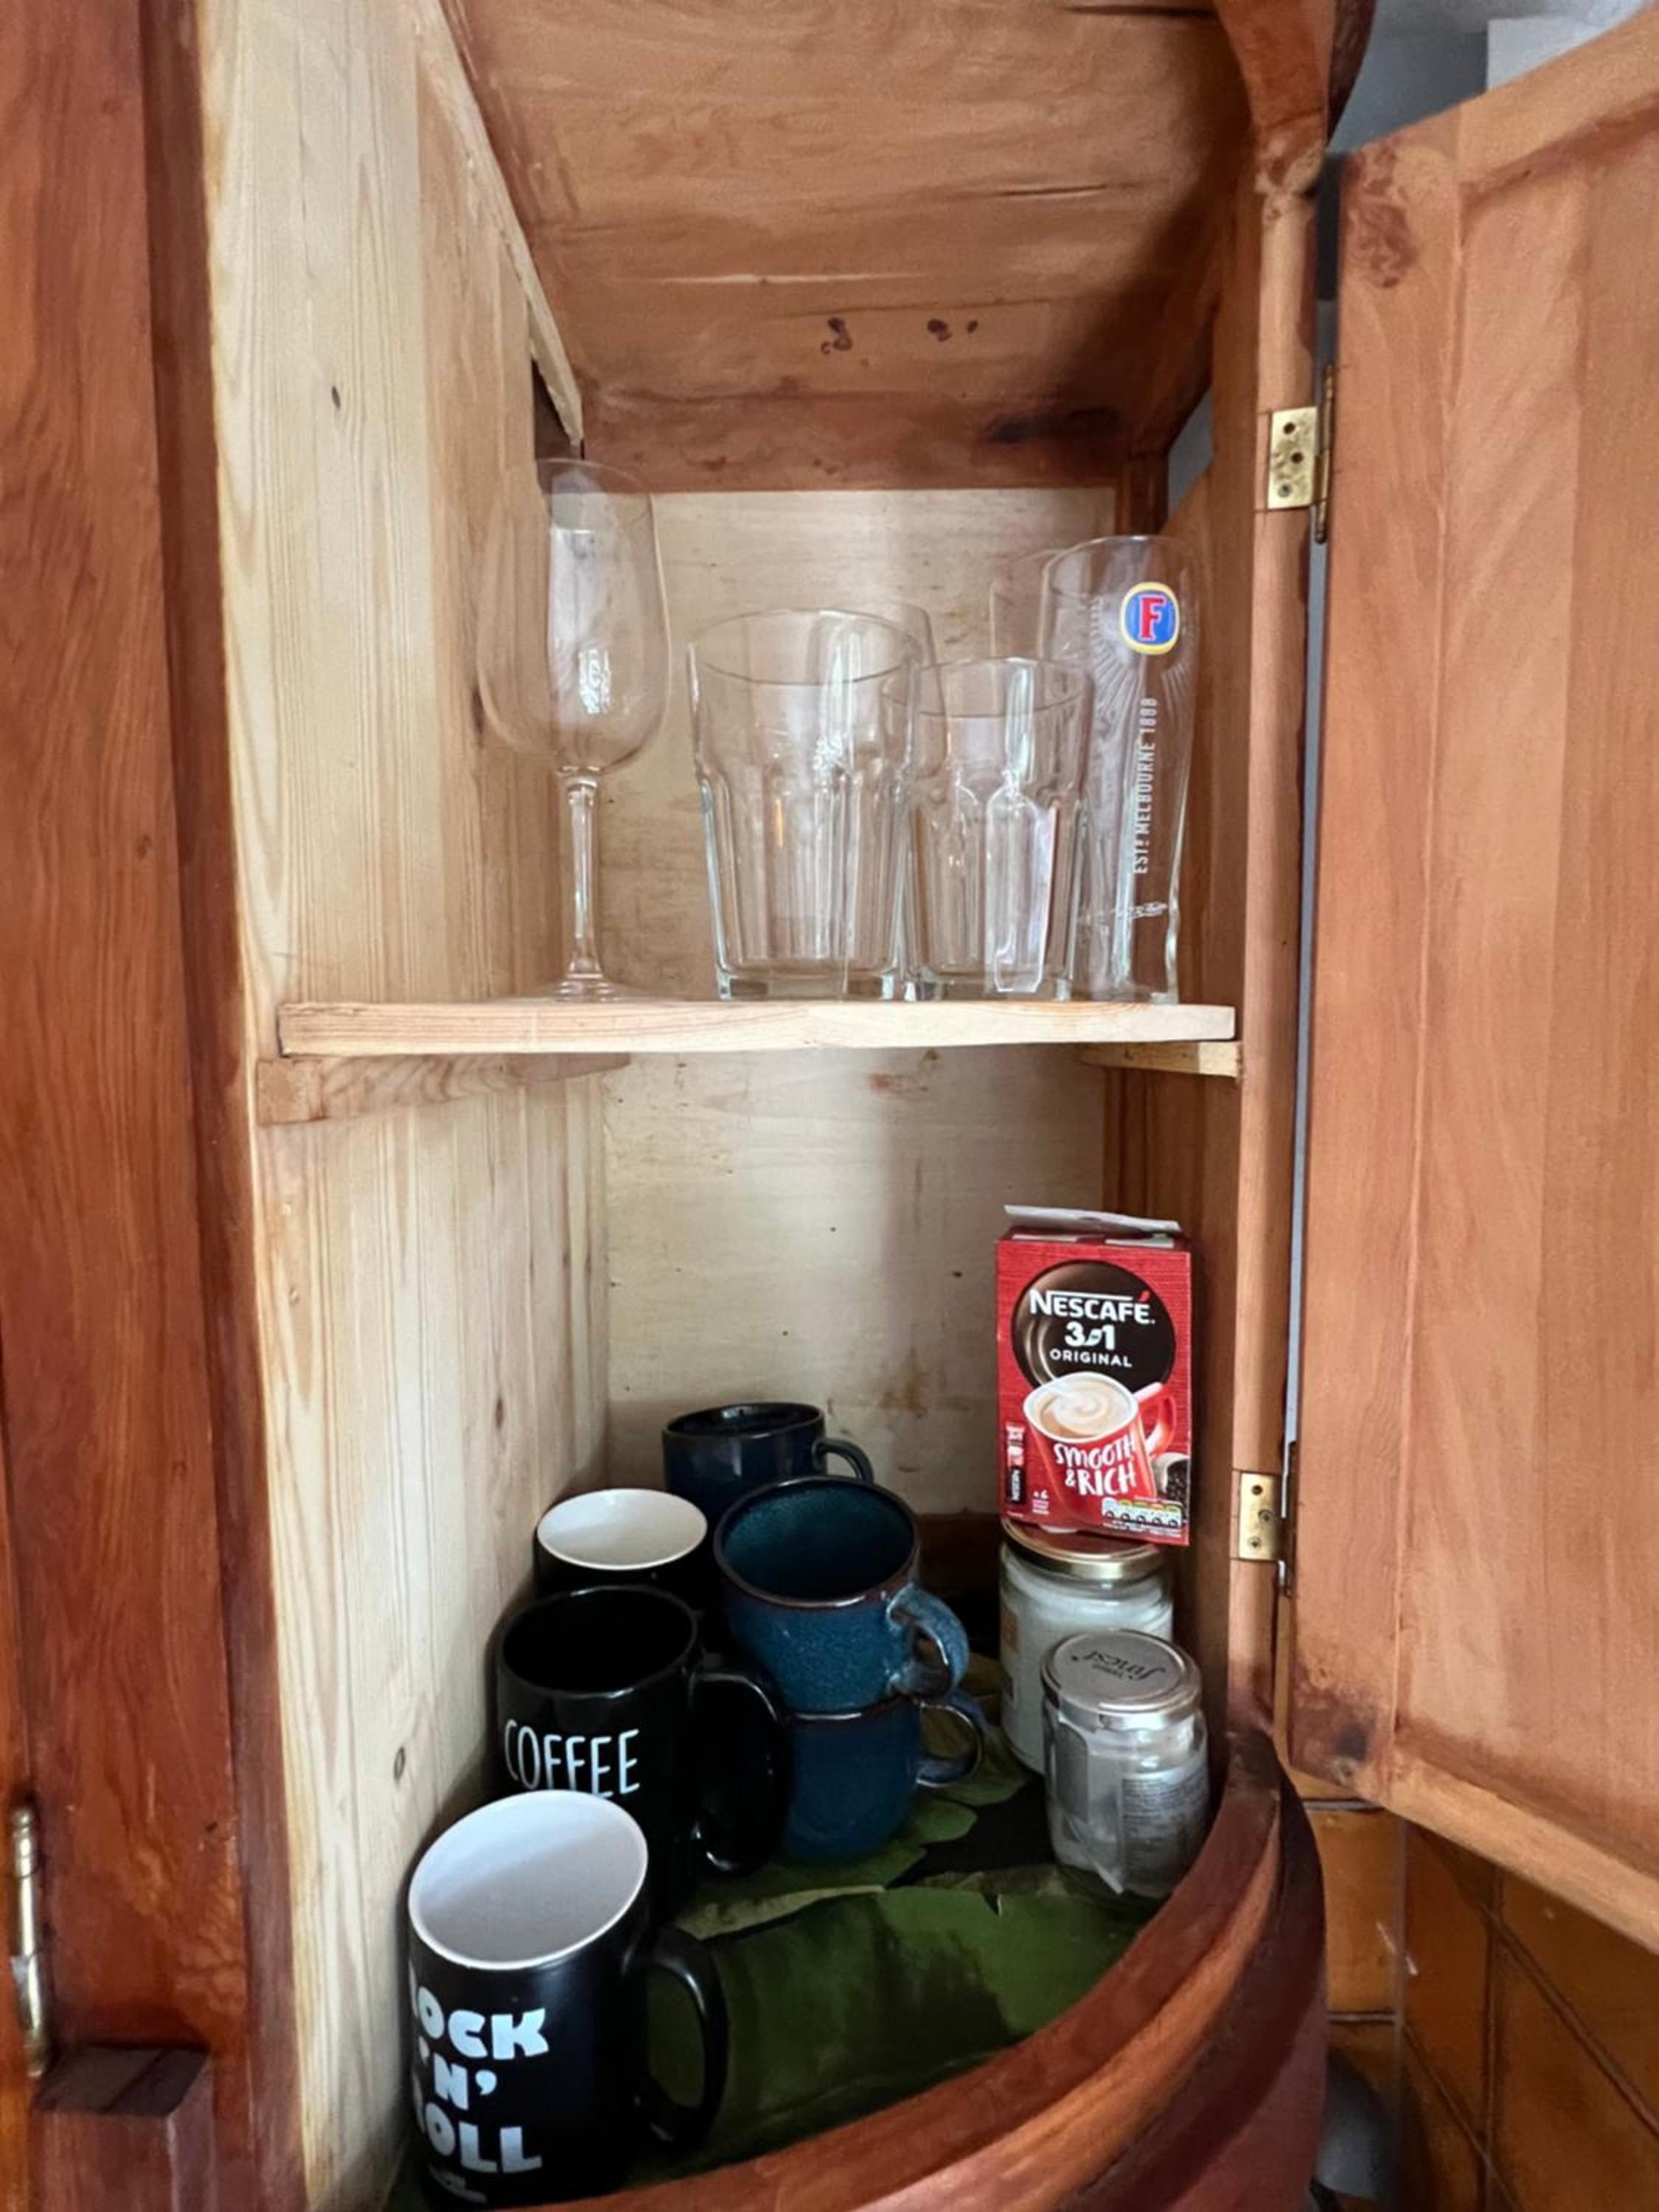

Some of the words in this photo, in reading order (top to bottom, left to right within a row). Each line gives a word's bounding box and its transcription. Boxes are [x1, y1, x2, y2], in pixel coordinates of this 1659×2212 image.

[1139, 595, 1165, 641] F
[1139, 698, 1158, 733] 1888
[1134, 742, 1155, 835] MELBOURNE
[1029, 1289, 1151, 1324] NESCAFÉ
[1049, 1349, 1133, 1368] ORIGINAL
[1053, 1434, 1136, 1470] SMOOTH
[1077, 1459, 1137, 1496] RICH
[504, 1719, 640, 1798] COFFEE
